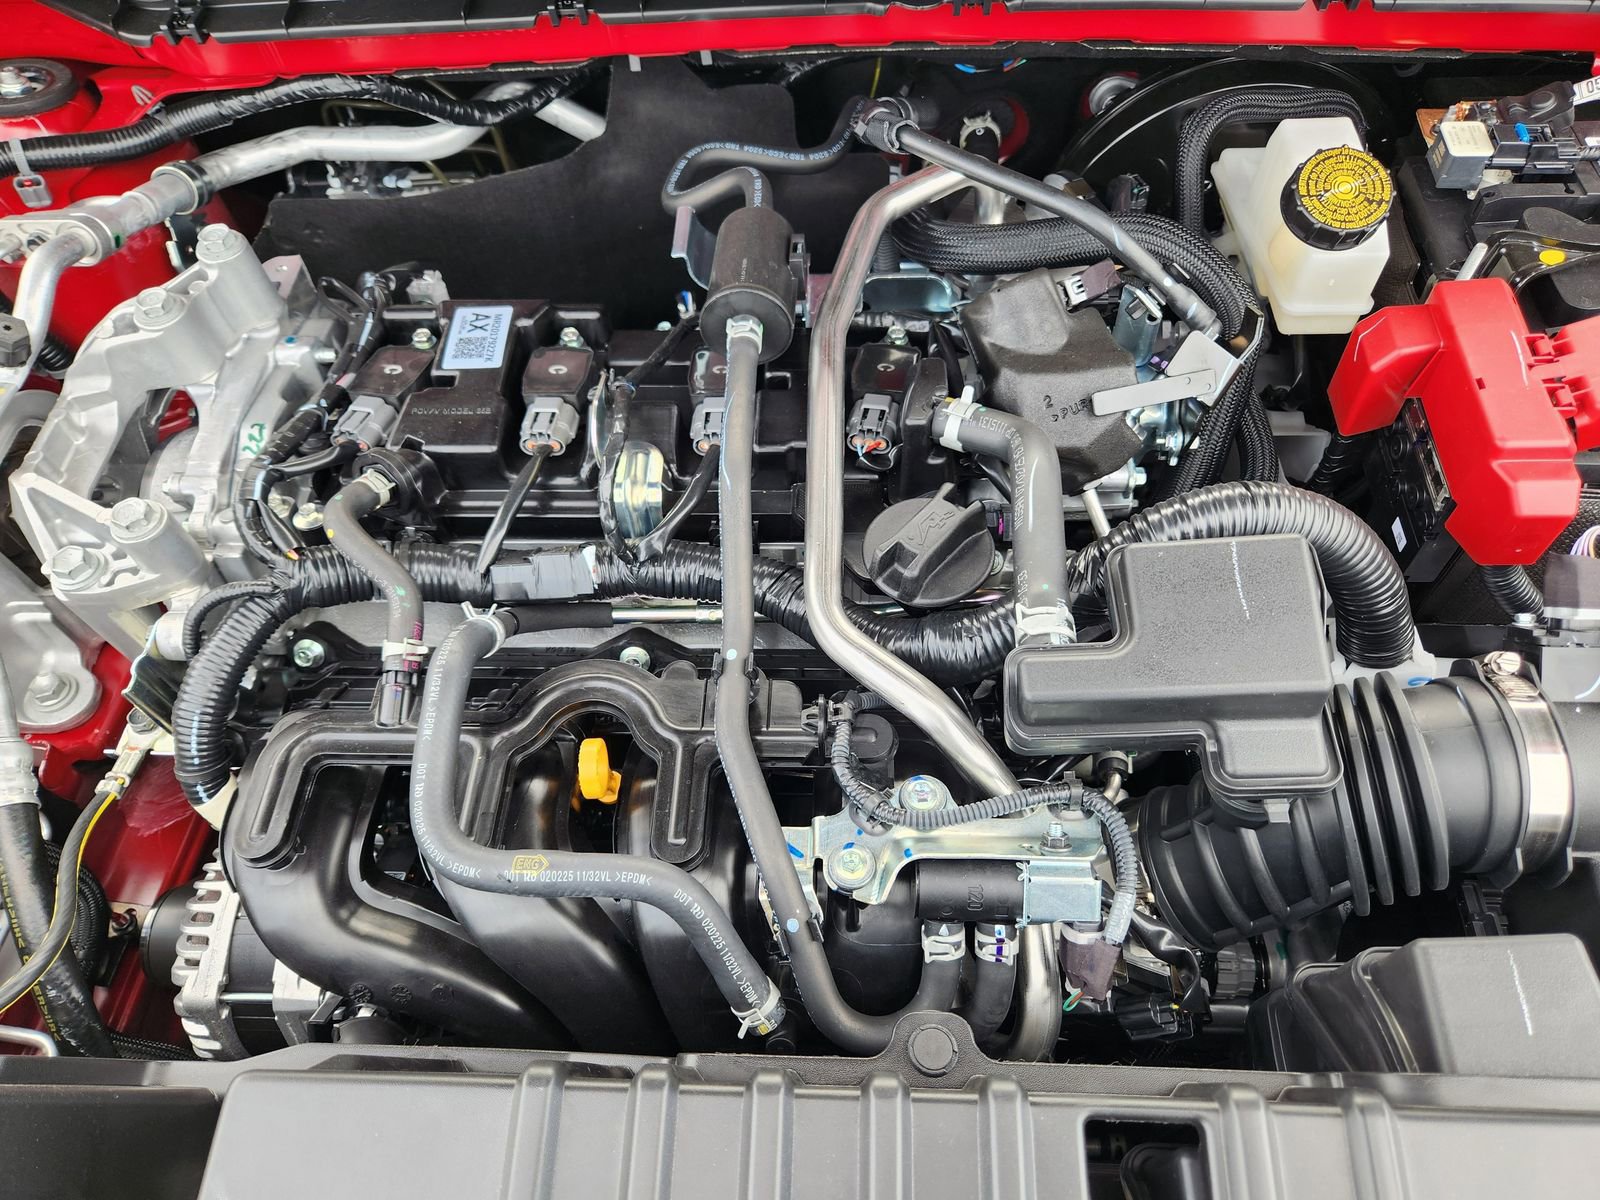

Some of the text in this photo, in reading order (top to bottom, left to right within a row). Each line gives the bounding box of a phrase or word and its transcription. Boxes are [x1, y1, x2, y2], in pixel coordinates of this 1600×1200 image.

[467, 313, 491, 333] AX
[516, 857, 540, 870] ENG
[540, 870, 574, 882] 020225
[967, 884, 984, 911] 120
[673, 888, 692, 906] DOT
[701, 918, 726, 950] 020225
